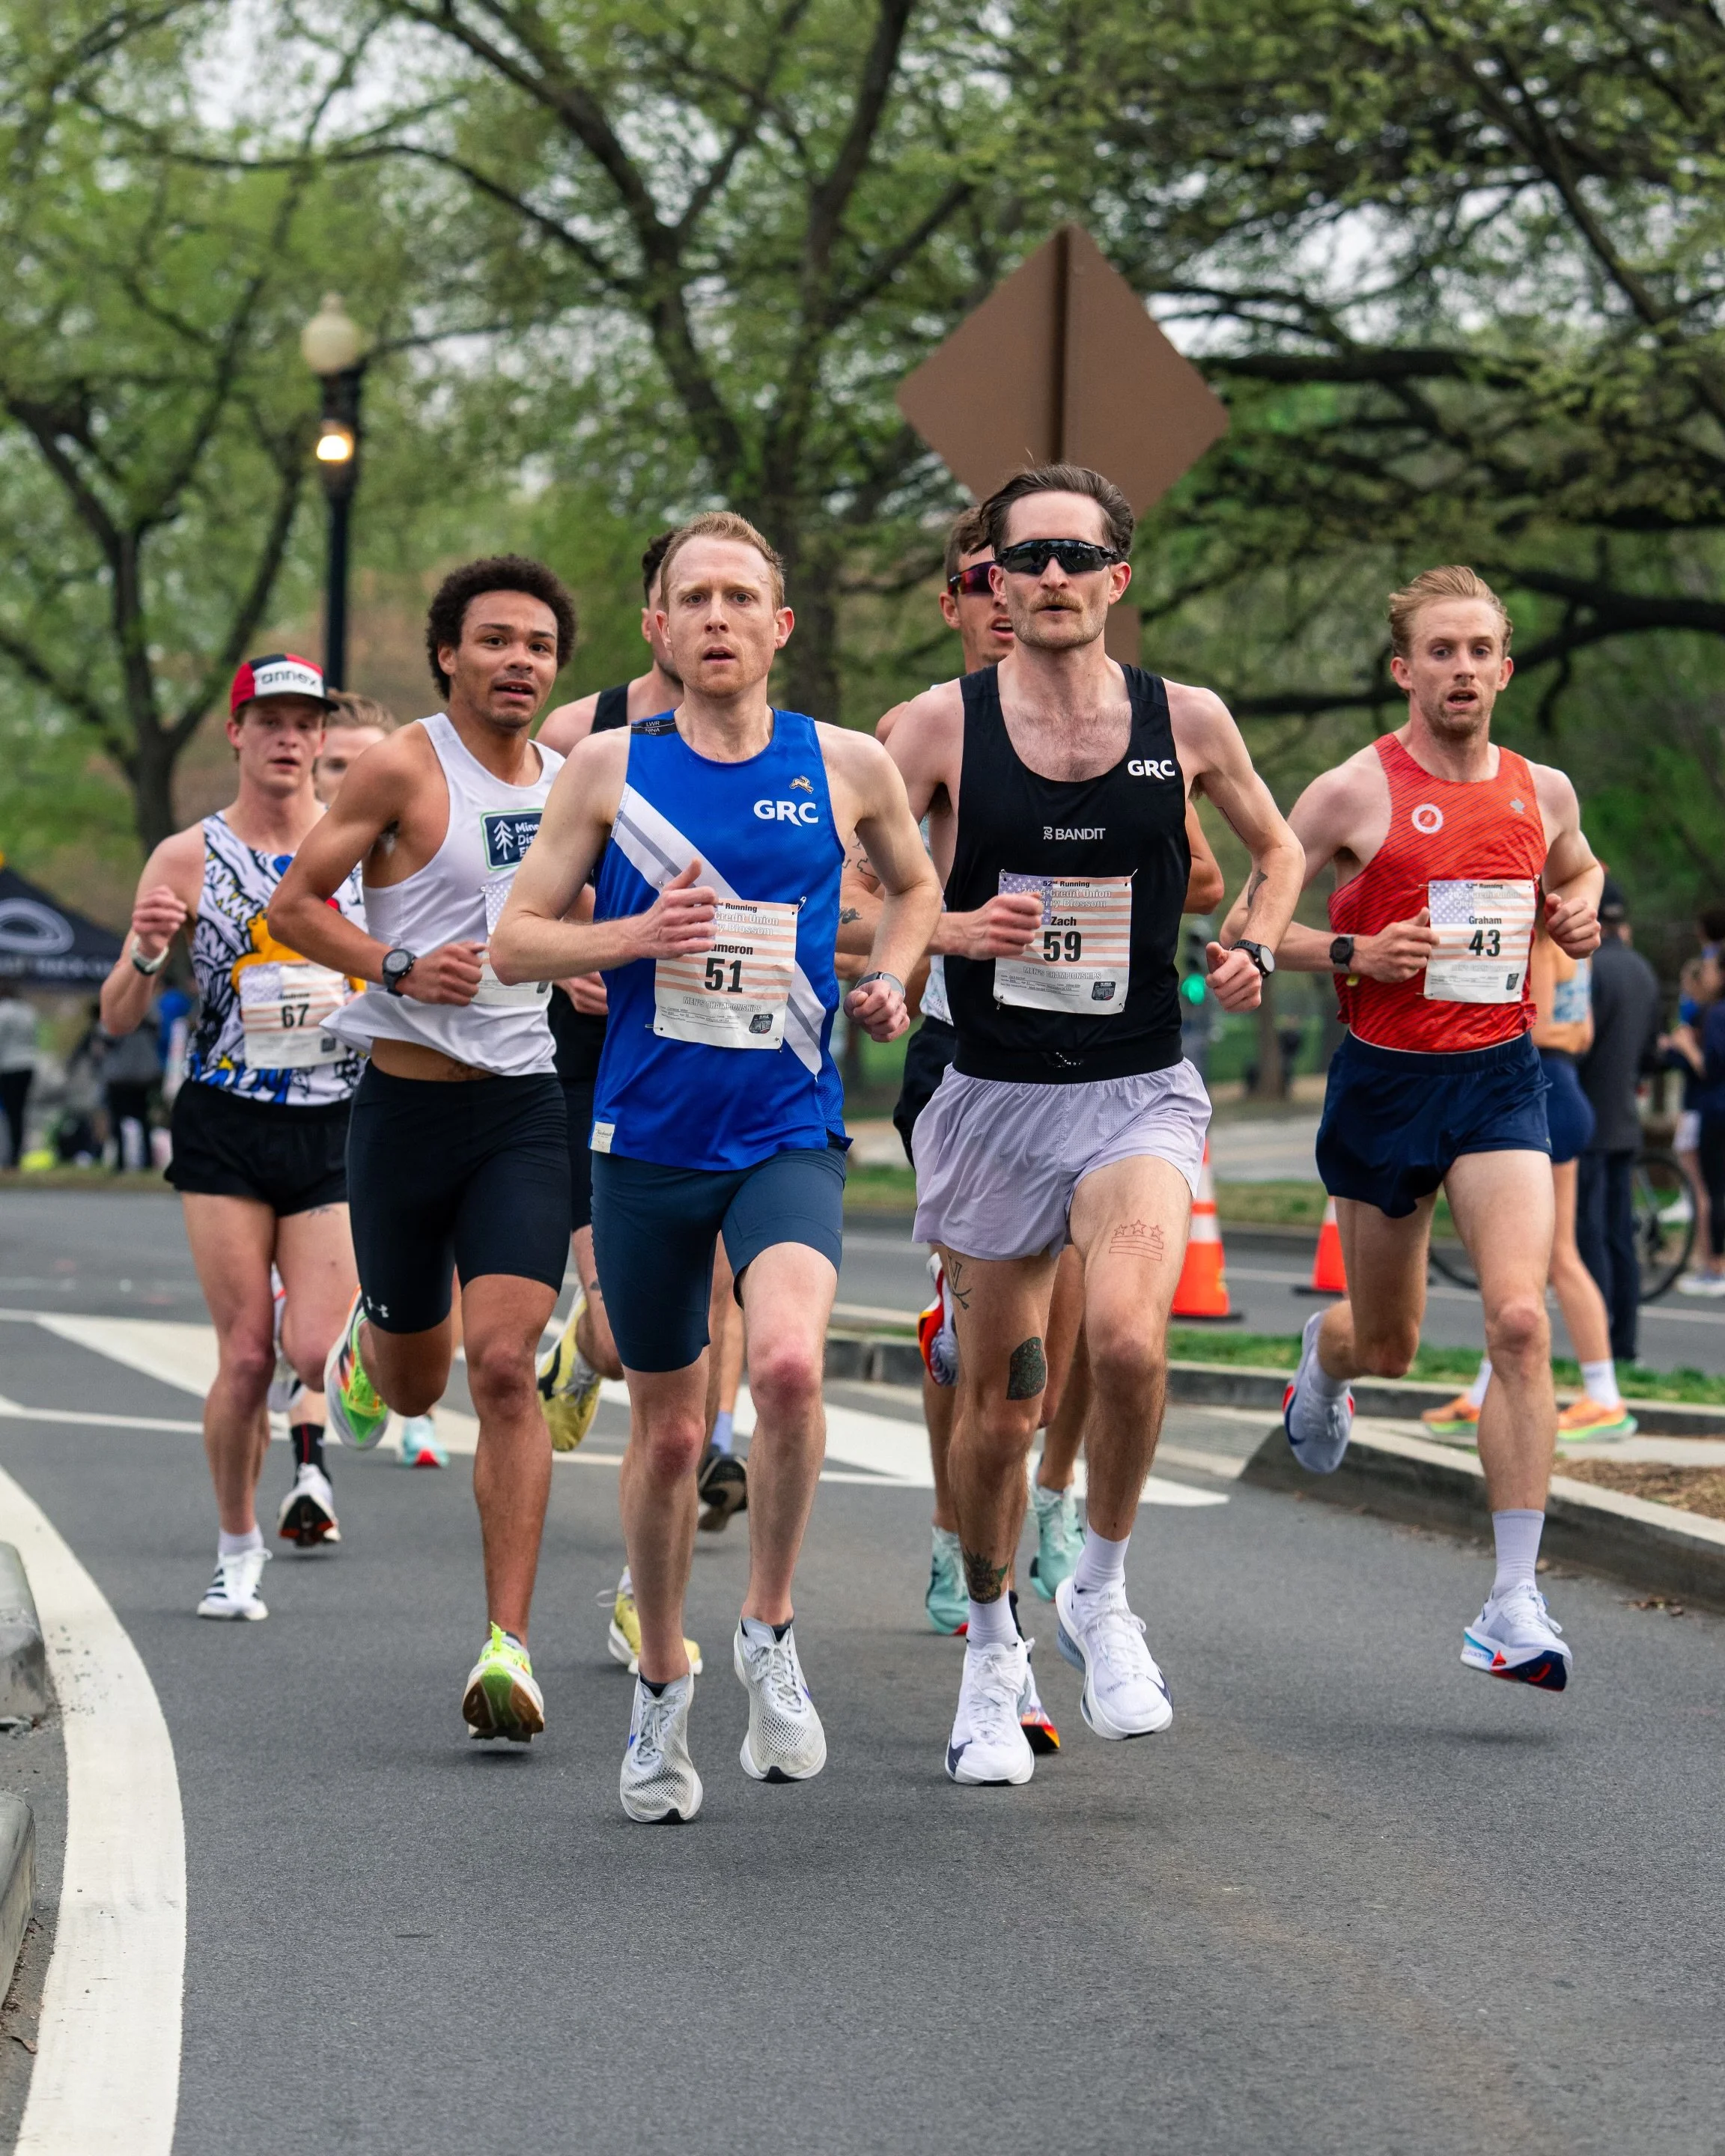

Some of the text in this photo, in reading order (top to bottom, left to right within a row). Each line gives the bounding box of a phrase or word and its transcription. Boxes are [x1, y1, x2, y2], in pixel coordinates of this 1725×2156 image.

[1128, 760, 1175, 780] GRC
[753, 800, 819, 827] GRC
[515, 822, 539, 833] Minn
[517, 834, 534, 845] Dis
[1055, 828, 1106, 841] BANDIT
[1059, 880, 1089, 889] Running
[1050, 889, 1080, 898] Credit
[1083, 889, 1112, 898] Union
[725, 903, 758, 913] Running
[1064, 899, 1107, 907] Blossom
[714, 911, 779, 926] Credit Union
[1050, 916, 1077, 926] Zach
[1469, 916, 1502, 925] Graham
[728, 922, 773, 936] Blossom
[711, 943, 754, 955] ameron
[1043, 931, 1082, 962] 59
[1468, 929, 1500, 957] 43
[705, 957, 743, 993] 51
[1045, 970, 1102, 980] CHAMPIONSHIPS
[683, 996, 761, 1013] MEN'S CHAMPIONSHIPS
[281, 1004, 310, 1028] 67
